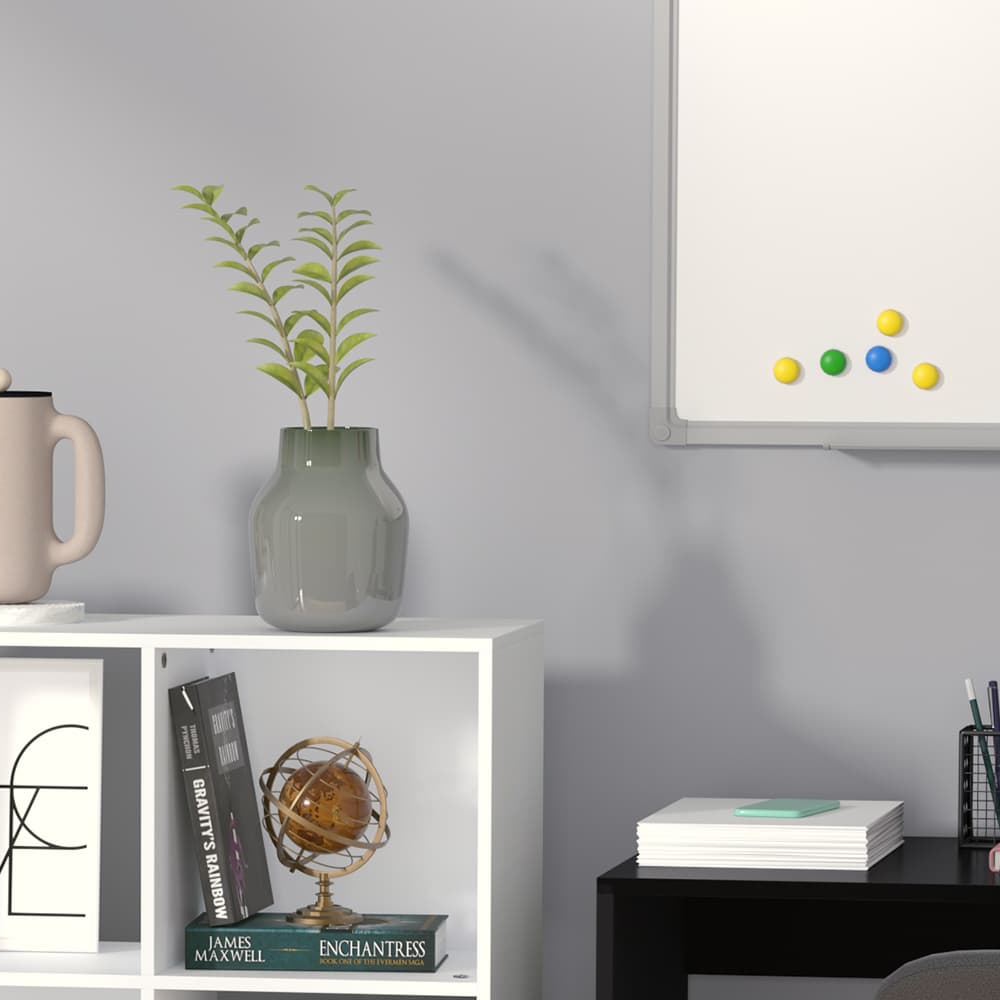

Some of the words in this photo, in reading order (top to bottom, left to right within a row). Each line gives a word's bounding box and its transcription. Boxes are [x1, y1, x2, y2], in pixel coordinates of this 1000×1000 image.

[193, 778, 216, 851] GRAVITY'S
[205, 854, 228, 919] RAINBOW
[208, 935, 251, 950] JAMES
[319, 939, 426, 958] ENCHANTRESS
[194, 949, 265, 963] MAXWELL
